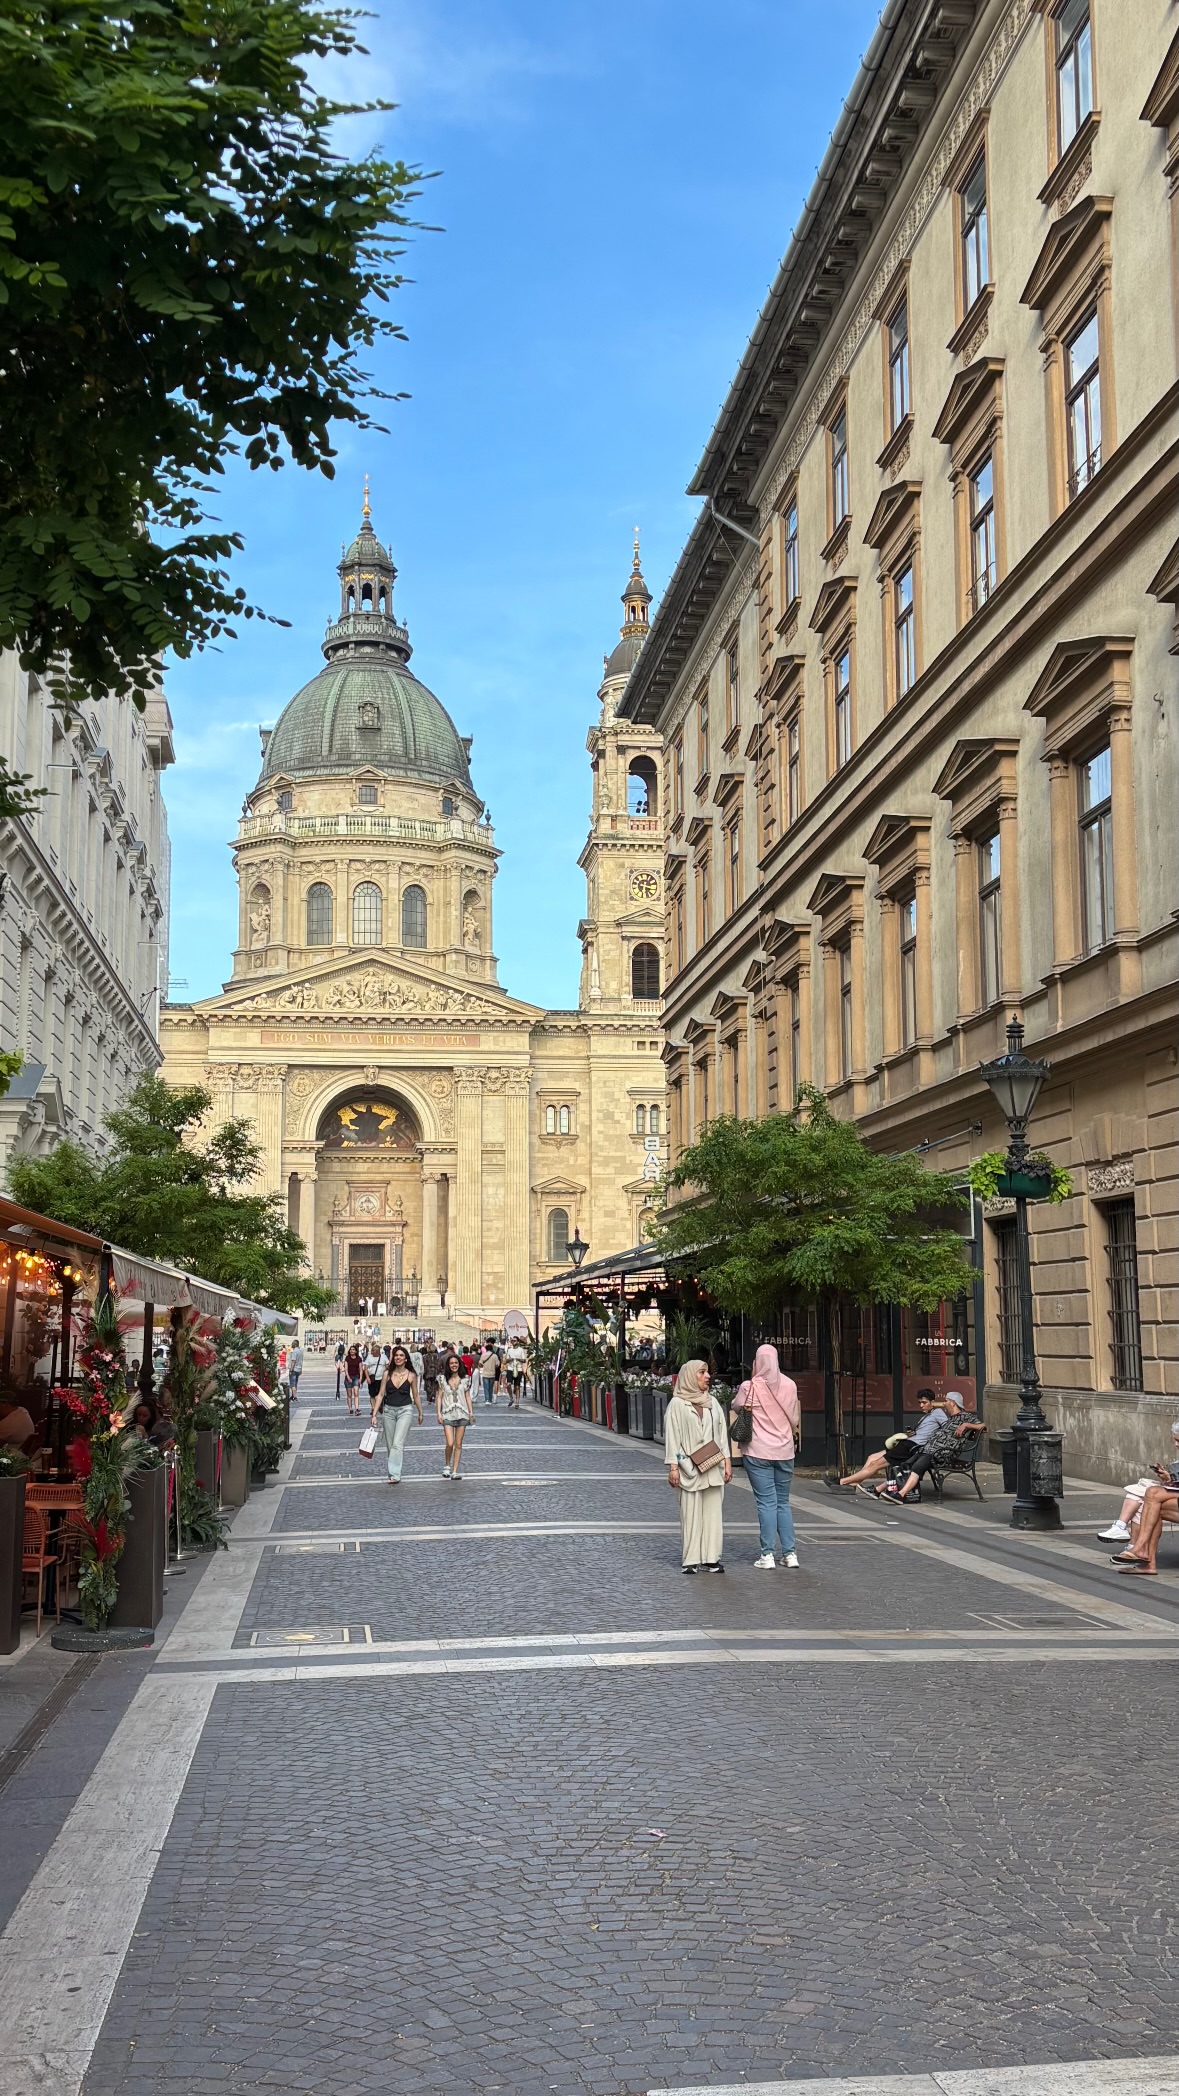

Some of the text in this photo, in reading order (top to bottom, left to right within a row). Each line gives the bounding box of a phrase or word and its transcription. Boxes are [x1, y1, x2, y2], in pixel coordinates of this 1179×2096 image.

[274, 1032, 298, 1042] EGO
[306, 1032, 331, 1043] SUM
[341, 1033, 361, 1043] VIA
[368, 1034, 416, 1044] VERITAS
[443, 1035, 468, 1045] VITA
[764, 1337, 812, 1345] FABBRICA
[915, 1338, 963, 1346] FABBRICA
